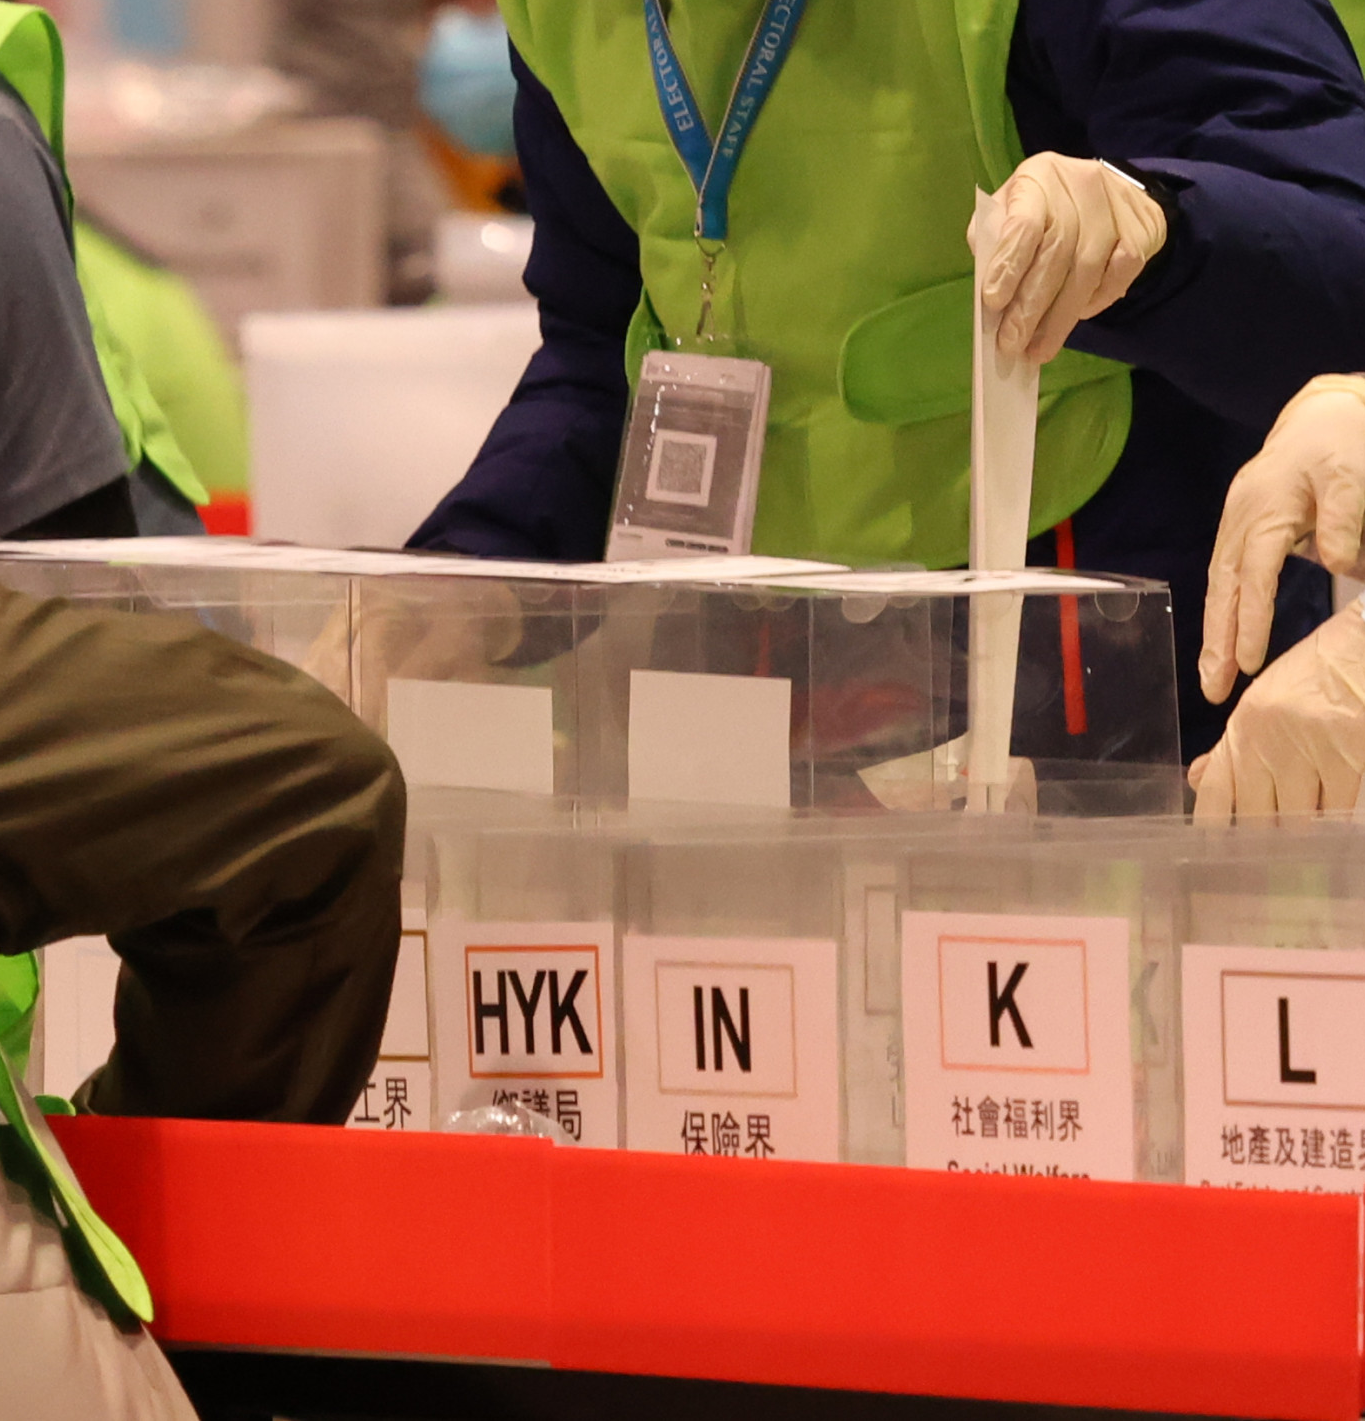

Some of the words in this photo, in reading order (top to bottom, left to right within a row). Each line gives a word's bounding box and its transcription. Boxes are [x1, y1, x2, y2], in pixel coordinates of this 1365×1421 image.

[472, 969, 593, 1056] HYK
[692, 985, 753, 1074] IN
[986, 961, 1034, 1049] K
[1277, 996, 1318, 1085] L
[352, 1076, 413, 1131] 工界
[680, 1109, 776, 1159] 保險界
[950, 1095, 1083, 1142] 社會福利界
